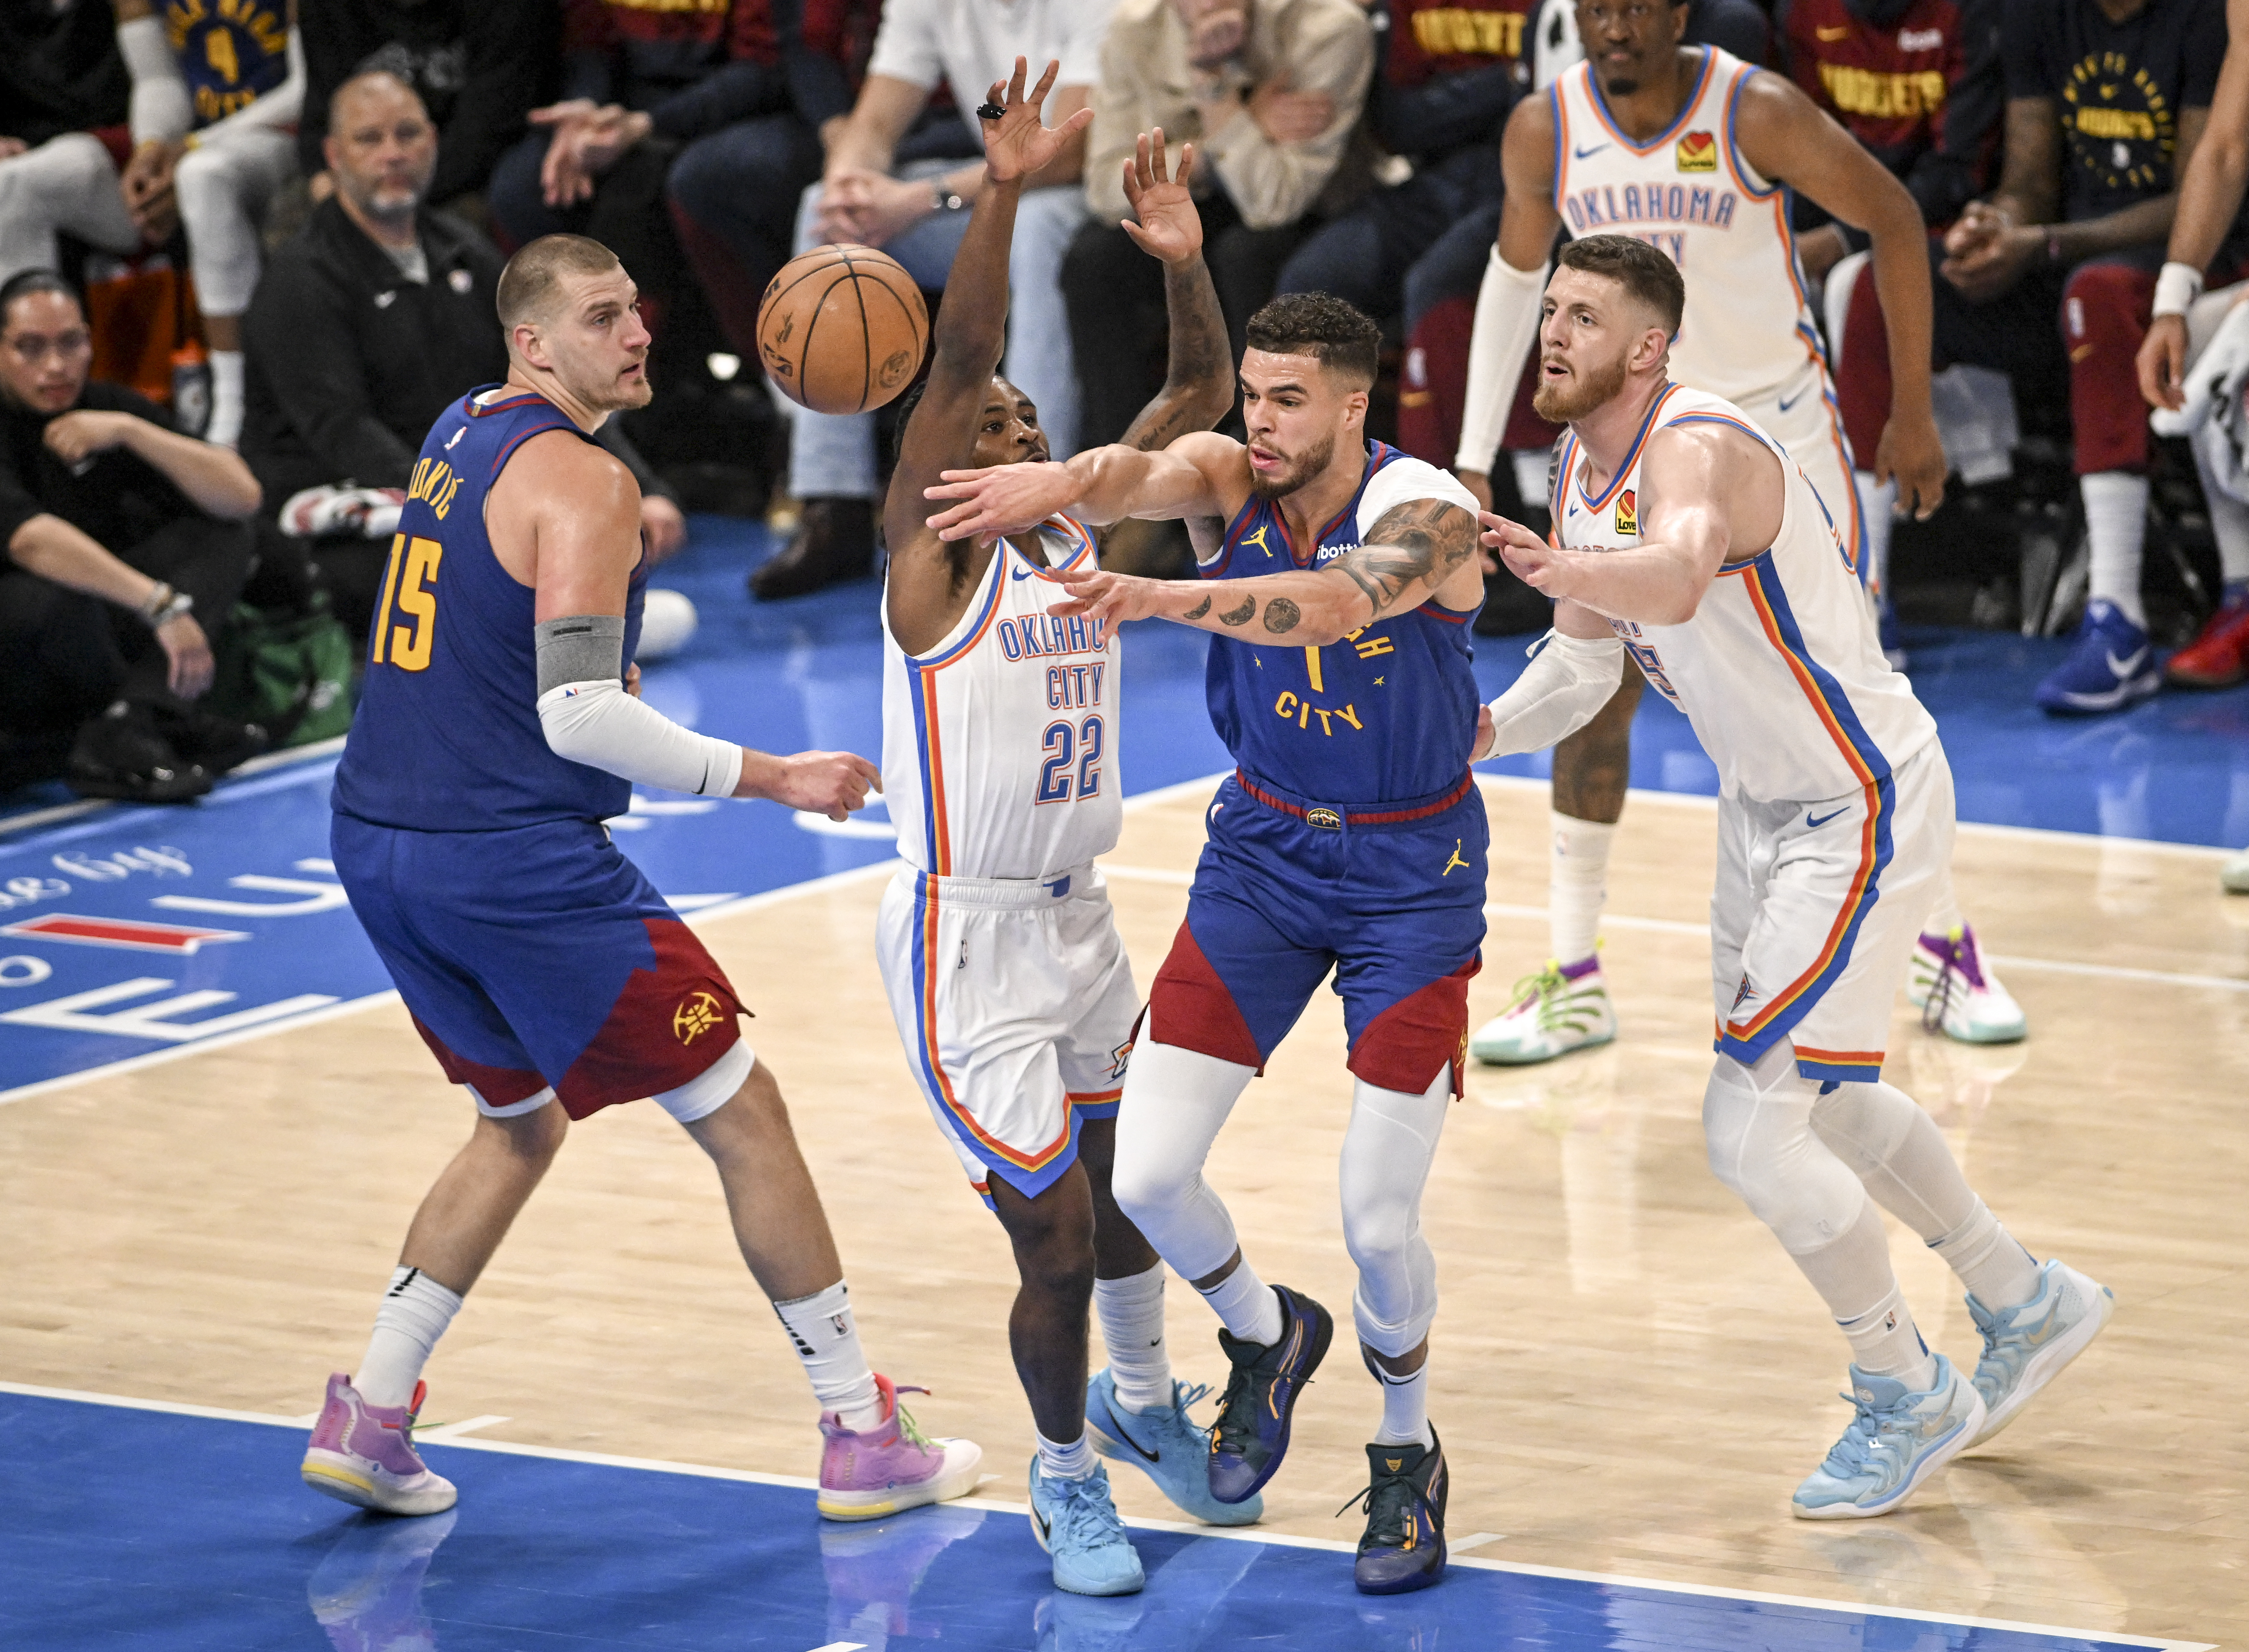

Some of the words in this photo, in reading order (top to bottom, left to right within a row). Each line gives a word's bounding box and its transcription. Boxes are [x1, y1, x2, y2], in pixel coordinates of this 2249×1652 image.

[1565, 182, 1738, 232] OKLAHOMA
[372, 531, 444, 672] 15
[998, 612, 1107, 662] OKLAHO
[1046, 661, 1105, 710] CITY
[1275, 690, 1363, 736] CITY
[1035, 713, 1105, 806] 22
